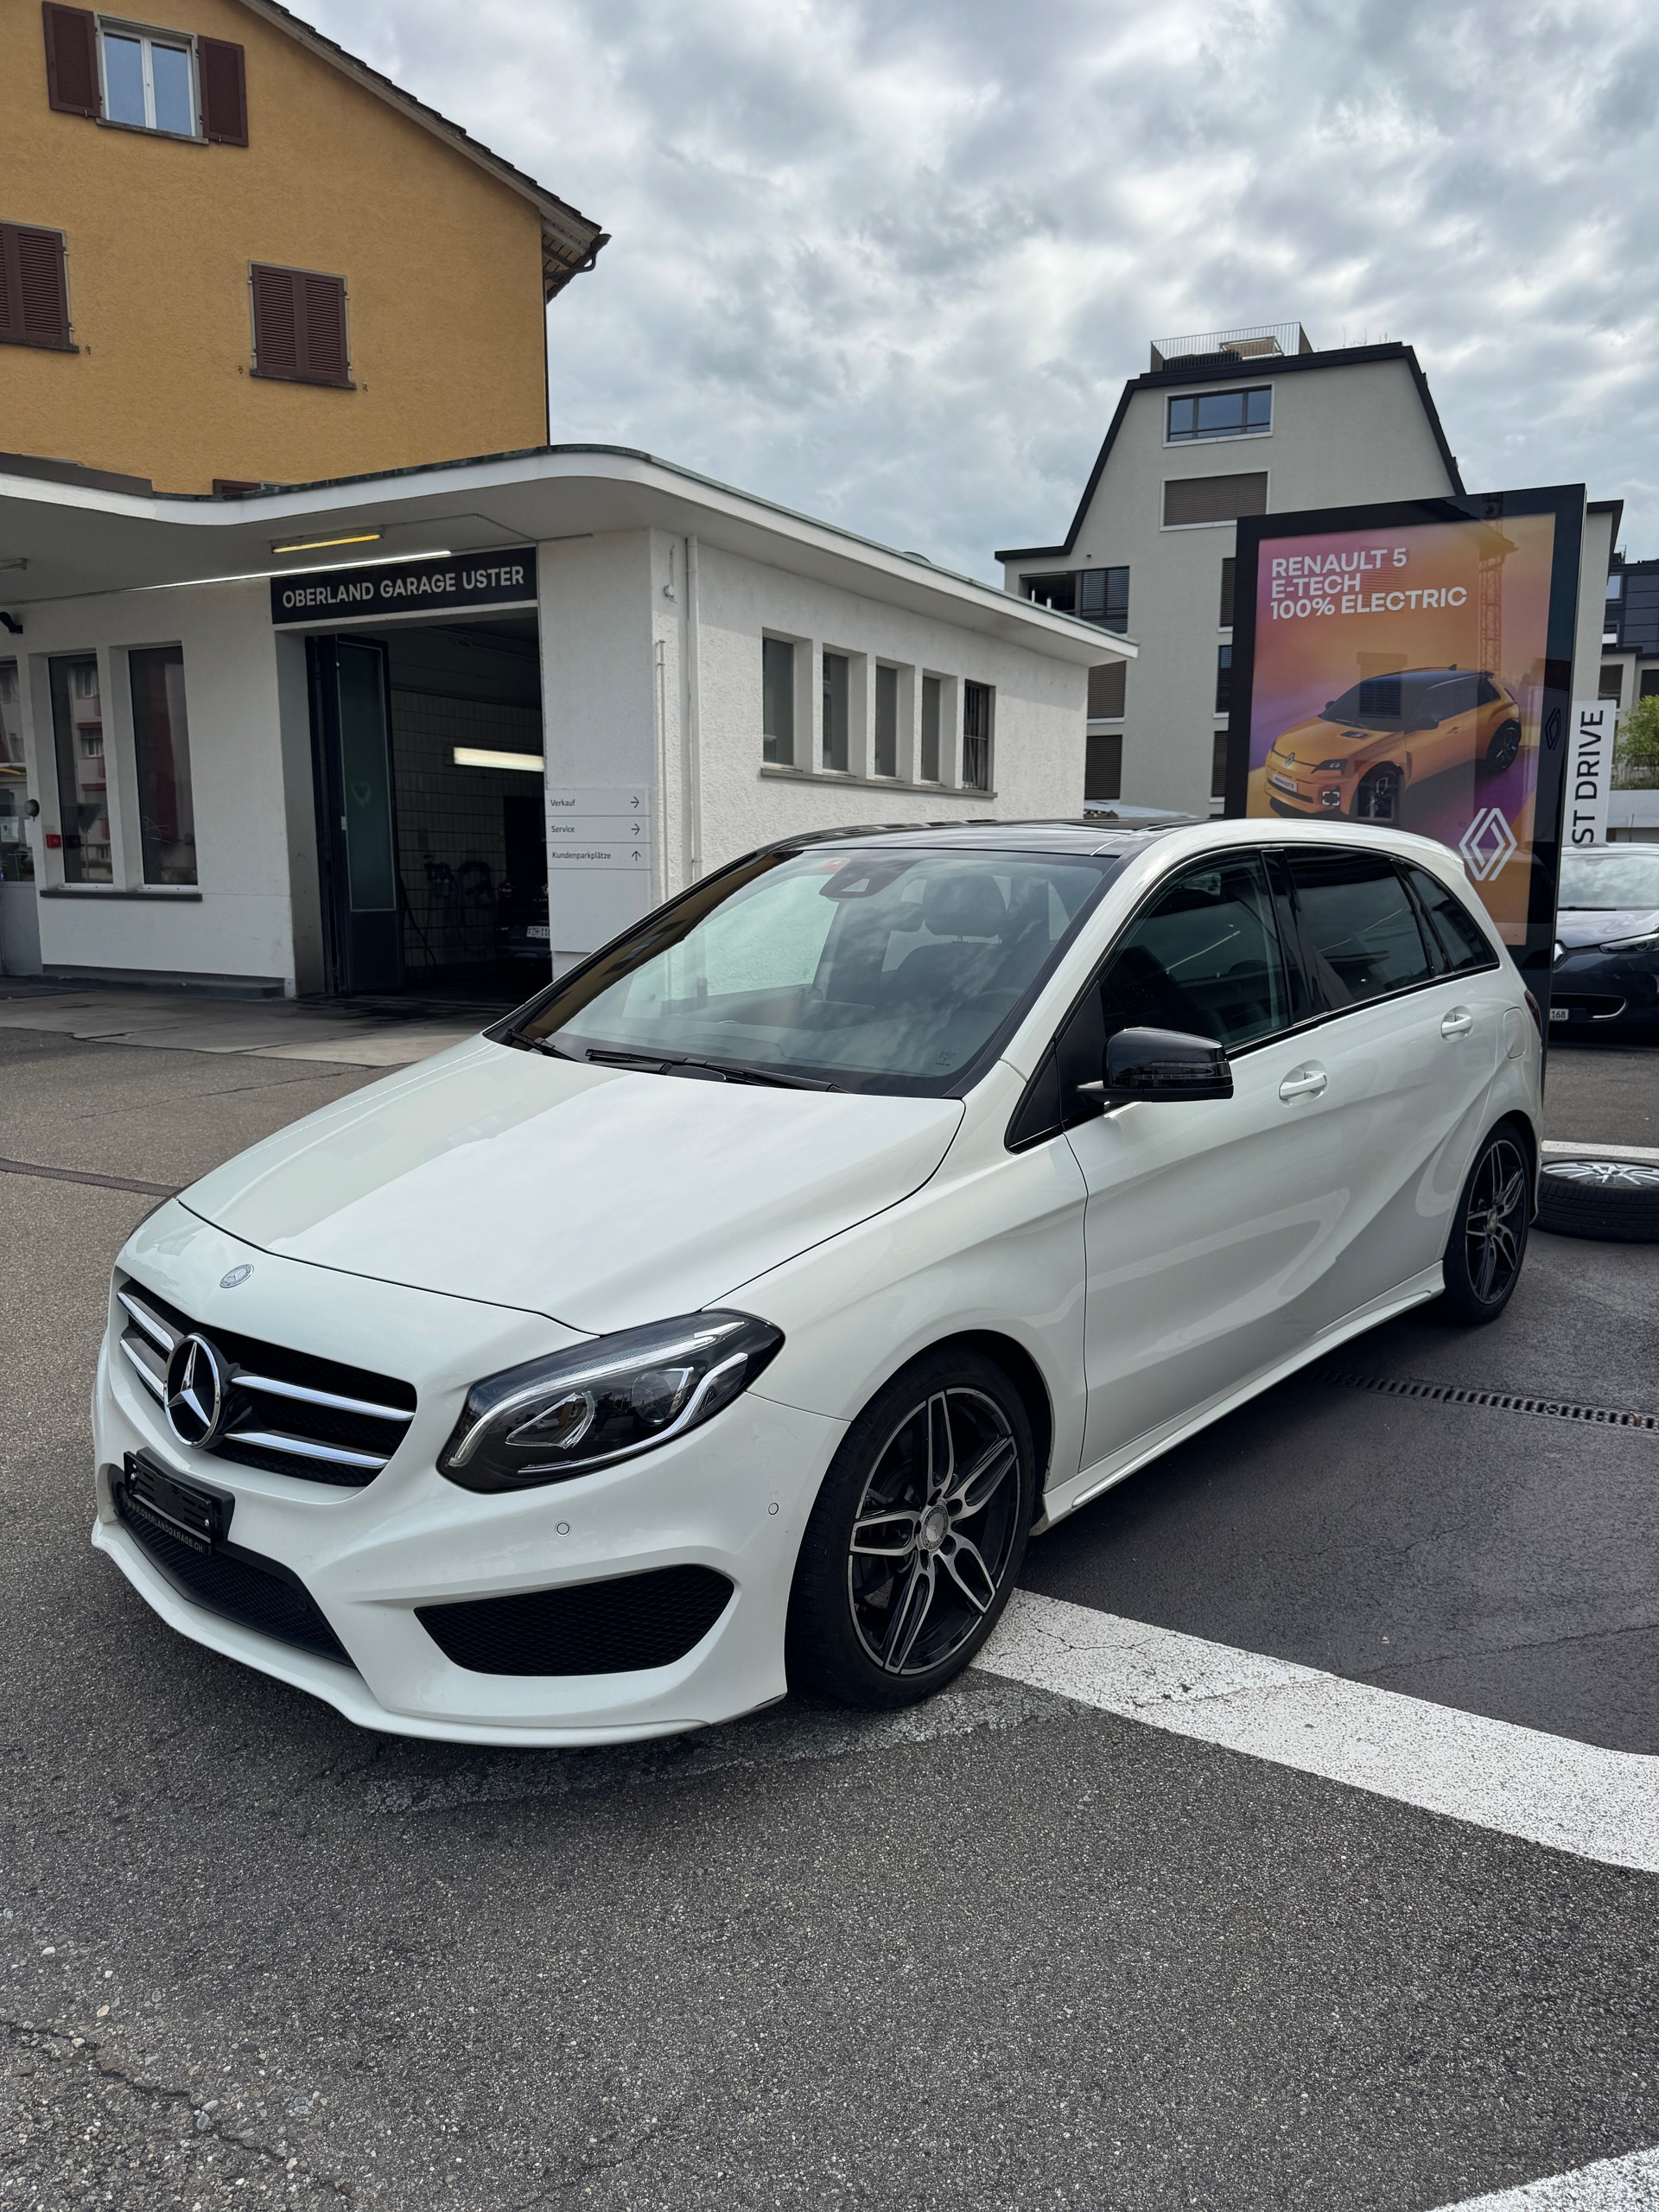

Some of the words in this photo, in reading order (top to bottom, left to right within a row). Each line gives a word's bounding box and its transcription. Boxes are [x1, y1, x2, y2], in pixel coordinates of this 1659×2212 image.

[1271, 549, 1388, 577] RENAULT
[1392, 548, 1407, 568] 5
[283, 582, 374, 607] OBERLAND
[379, 573, 456, 598] GARAGE
[462, 566, 524, 589] USTER
[1271, 573, 1362, 599] E-TECH
[1270, 596, 1335, 620] 100%
[1341, 586, 1467, 613] ELECTRIC
[1574, 709, 1604, 801] DRIVE
[552, 851, 612, 860] Kundenparkplätze
[1552, 1010, 1566, 1019] 168
